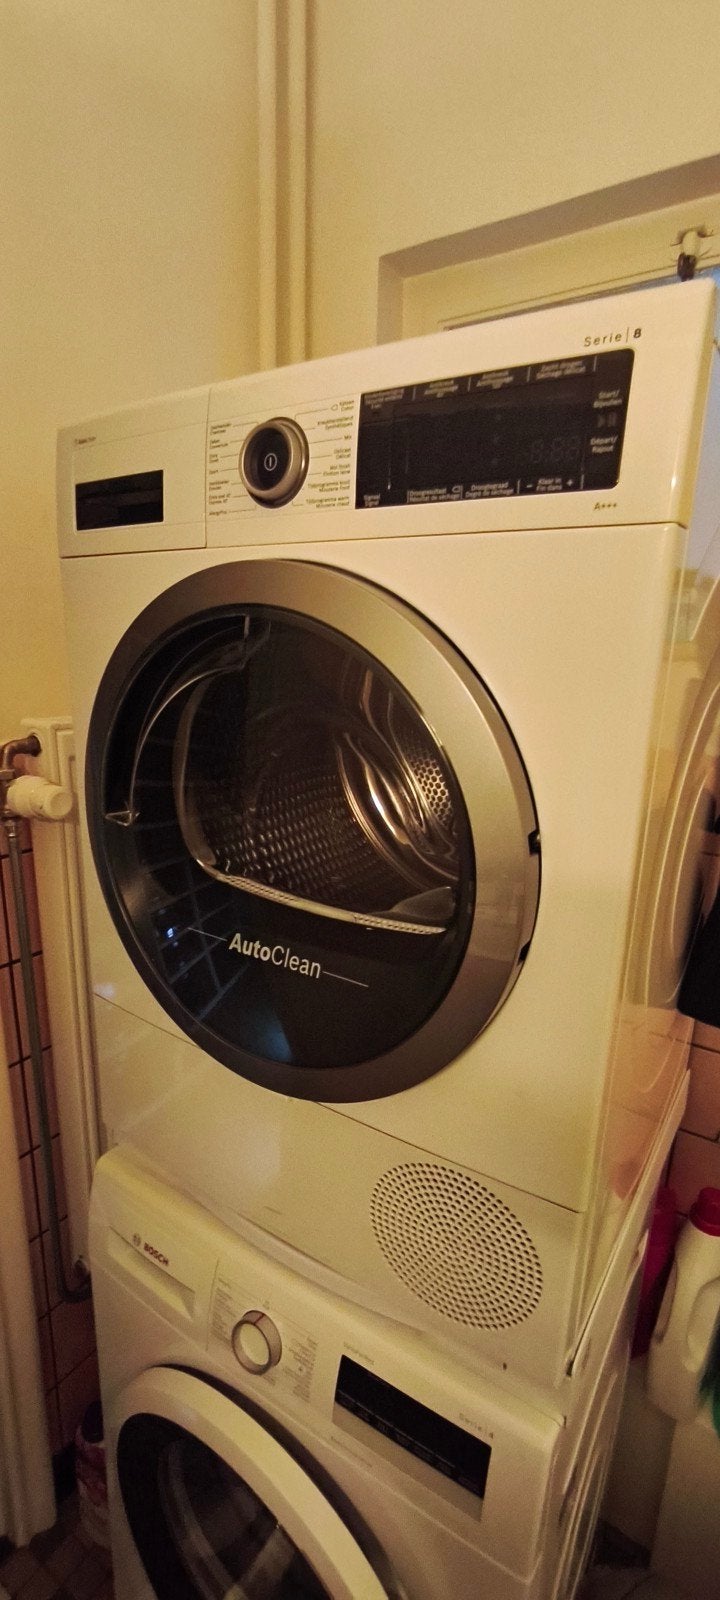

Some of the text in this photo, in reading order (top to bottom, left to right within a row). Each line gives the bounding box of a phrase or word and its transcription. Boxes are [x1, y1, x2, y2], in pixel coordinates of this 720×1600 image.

[583, 327, 642, 347] Serie 8
[228, 932, 321, 979] AutoClean
[144, 1242, 169, 1266] BOSCH
